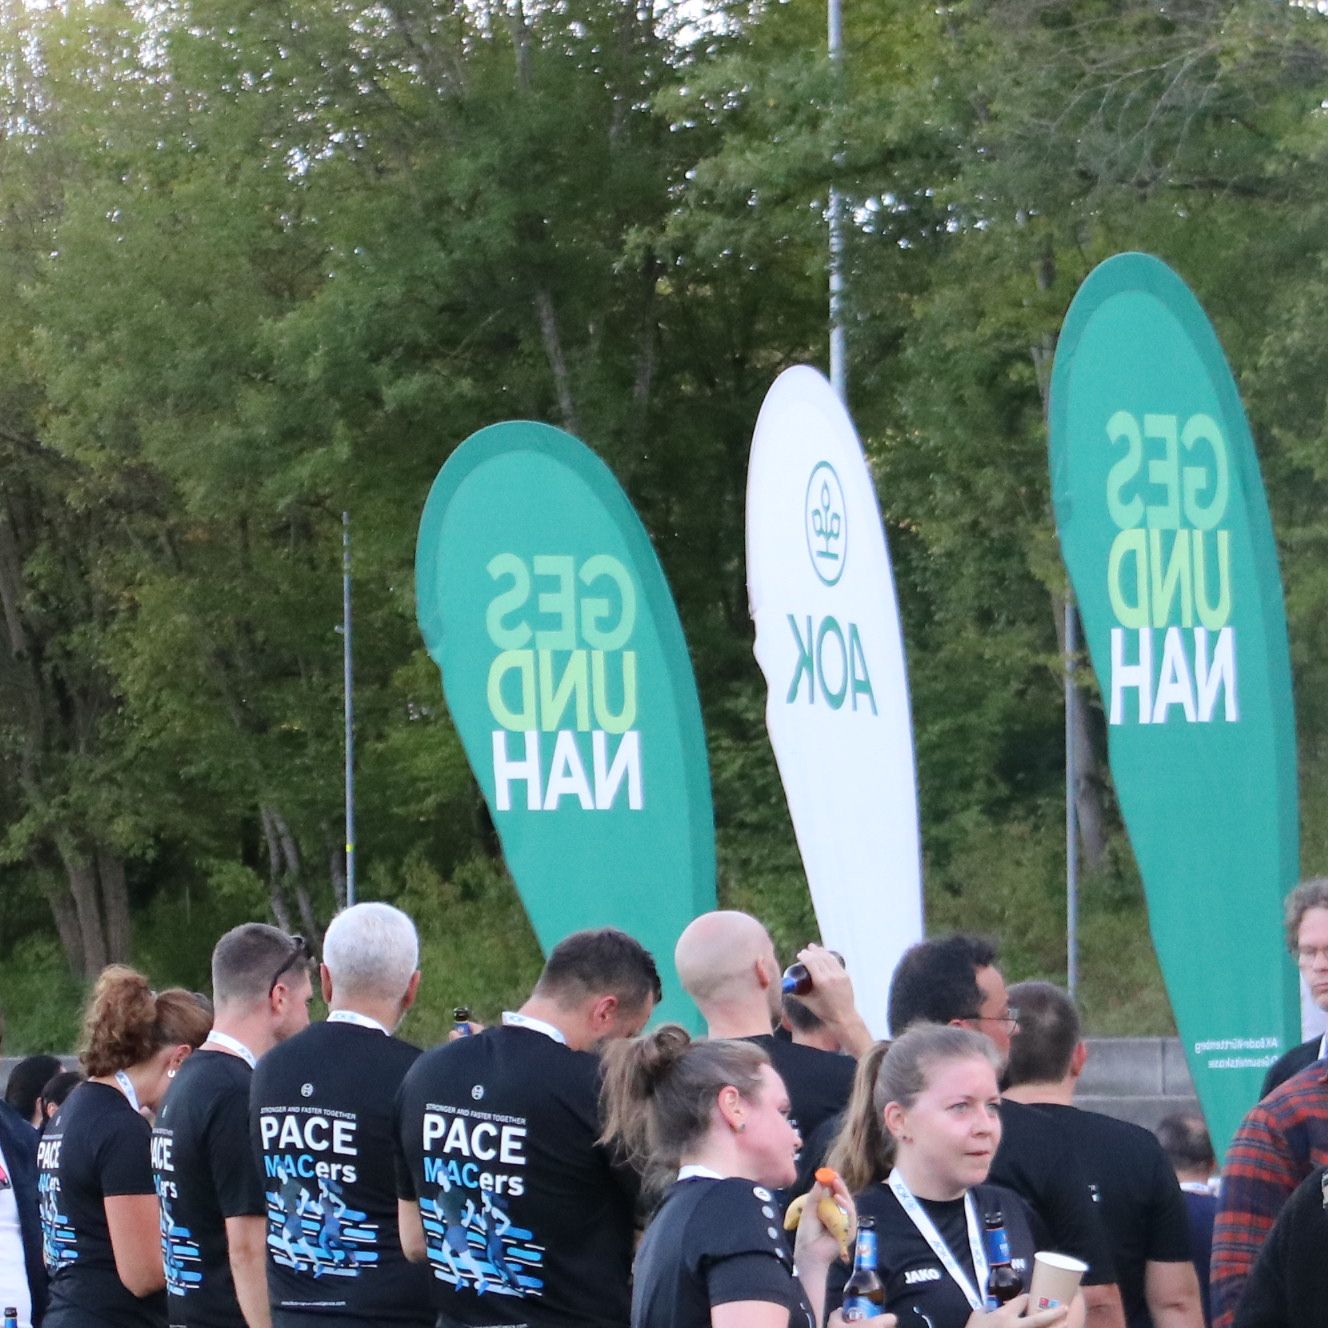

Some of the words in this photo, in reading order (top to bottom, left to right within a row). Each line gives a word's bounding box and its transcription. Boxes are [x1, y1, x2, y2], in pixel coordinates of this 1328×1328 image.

[260, 1106, 286, 1114] STRONGER
[301, 1107, 322, 1115] FASTER
[323, 1109, 356, 1120] TOGETHER
[425, 1103, 455, 1114] STRONGER
[456, 1108, 470, 1117] AND
[471, 1110, 491, 1120] FASTER
[492, 1114, 526, 1125] TOGETHER
[260, 1115, 358, 1156] PACE
[422, 1113, 528, 1165] PACE
[37, 1140, 62, 1169] PACE
[264, 1154, 357, 1184] MACers
[423, 1156, 525, 1197] MACers
[904, 1268, 941, 1284] JAKO
